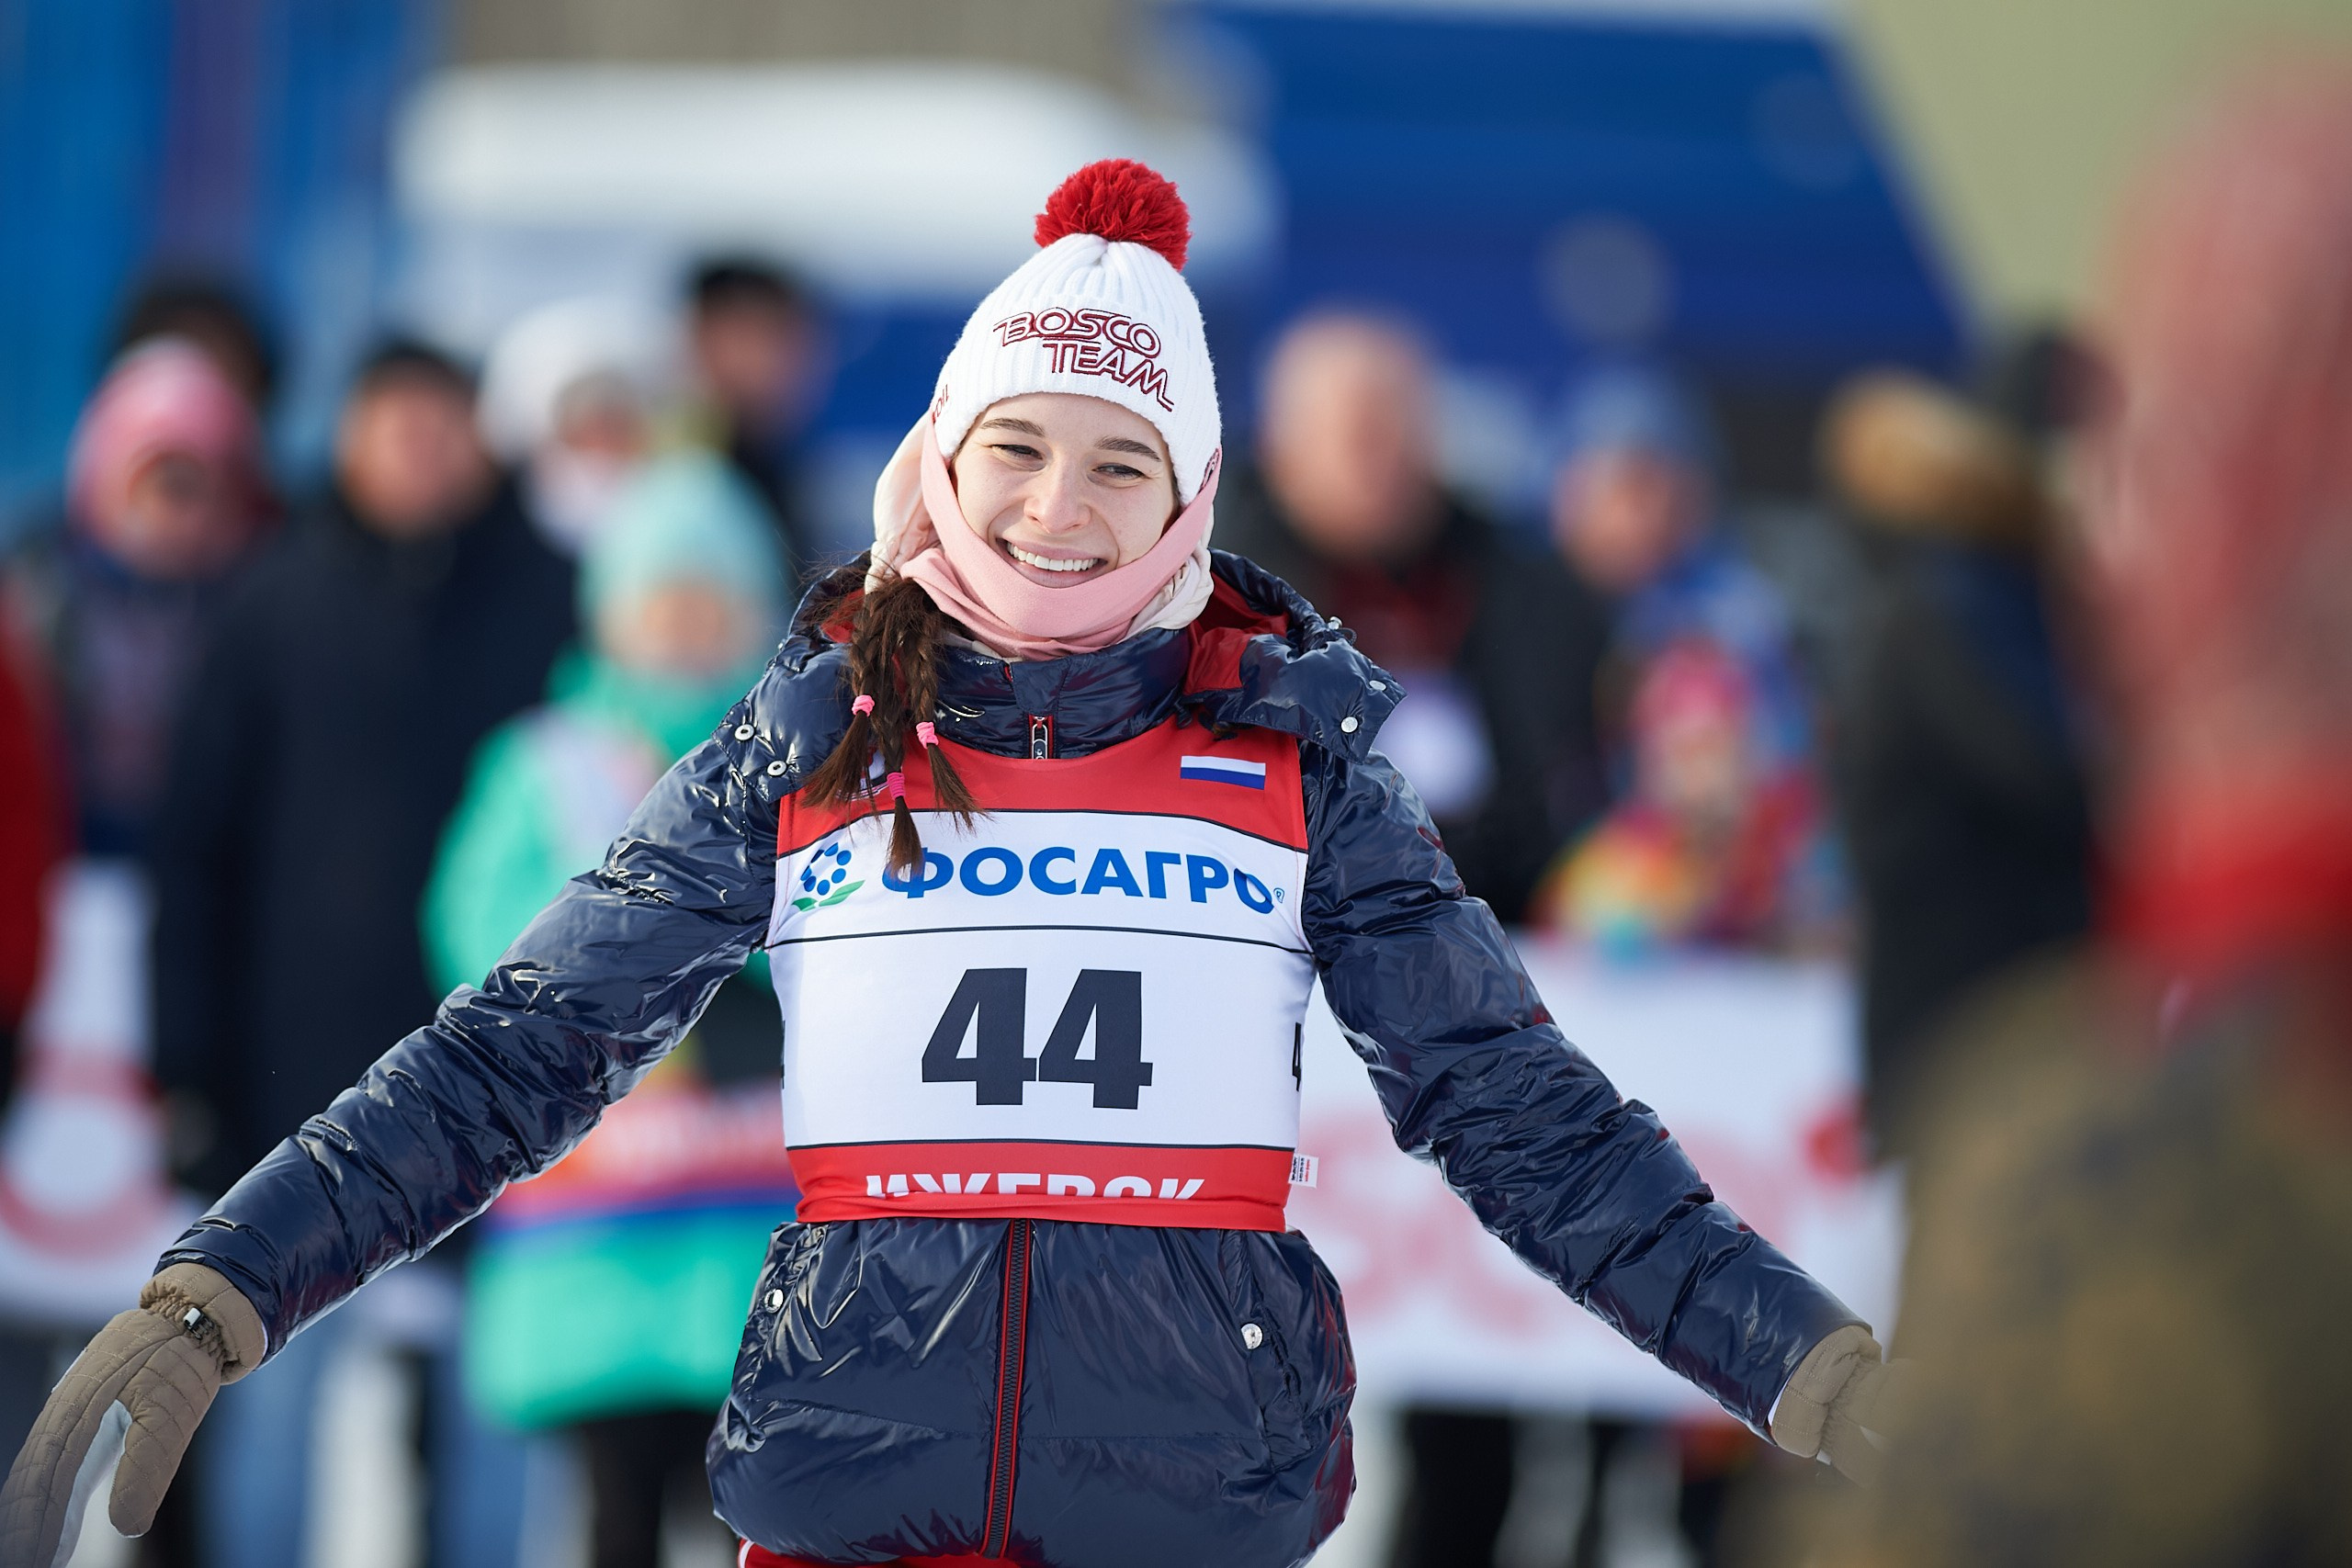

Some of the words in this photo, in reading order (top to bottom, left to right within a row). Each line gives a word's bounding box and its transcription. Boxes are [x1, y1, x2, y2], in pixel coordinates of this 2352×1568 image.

[993, 306, 1161, 358] BOSCO
[1043, 338, 1175, 412] TEAM
[922, 967, 1153, 1110] 44
